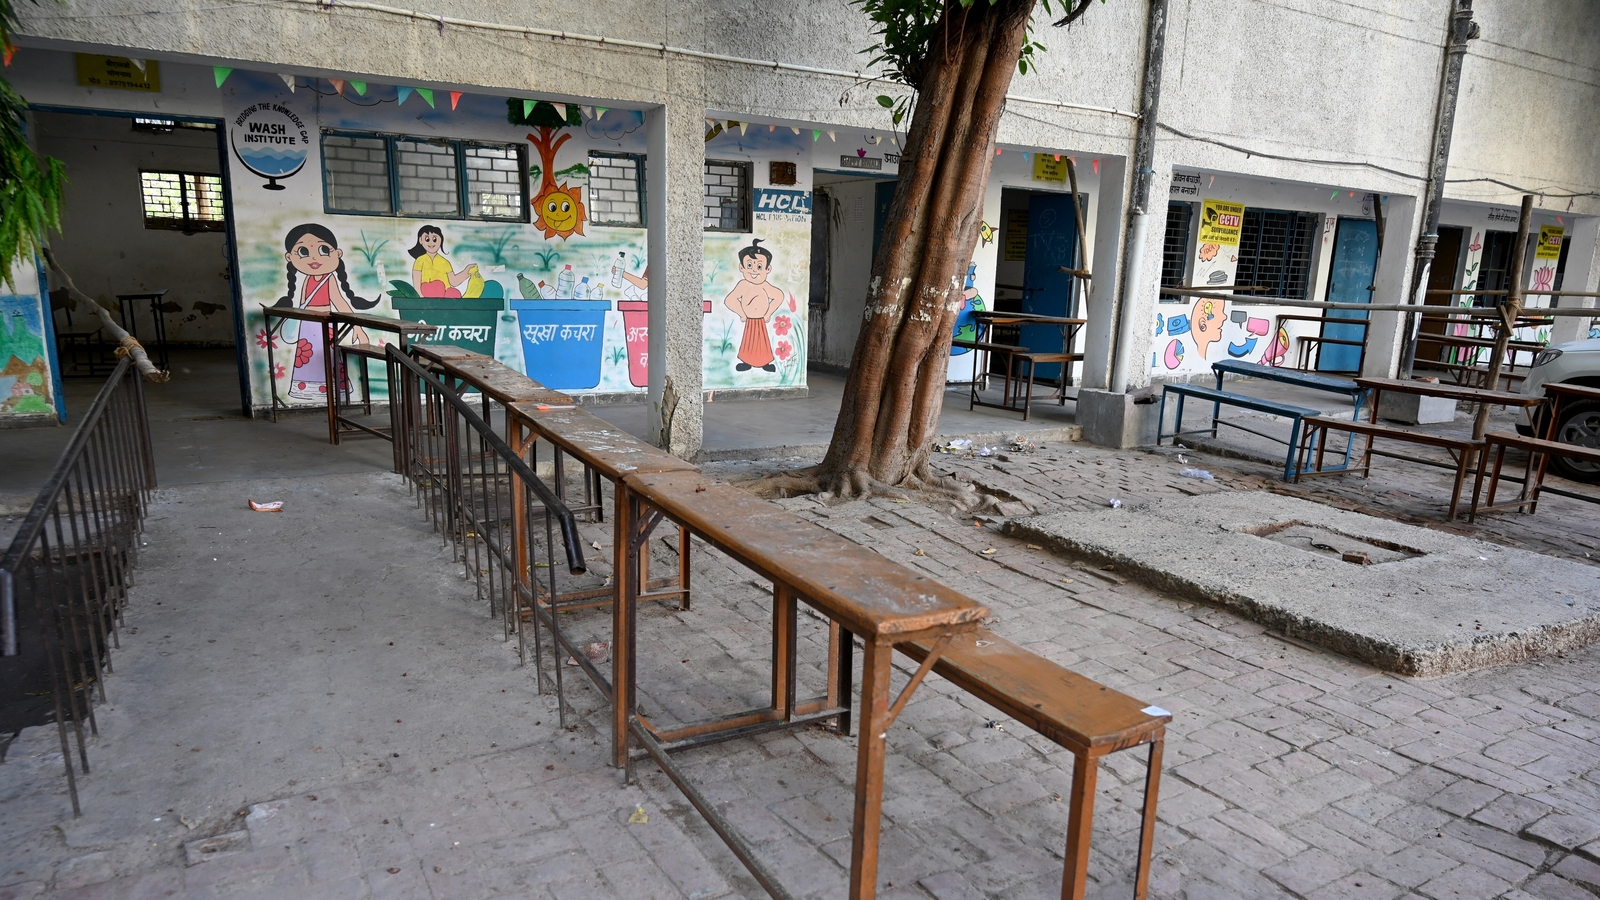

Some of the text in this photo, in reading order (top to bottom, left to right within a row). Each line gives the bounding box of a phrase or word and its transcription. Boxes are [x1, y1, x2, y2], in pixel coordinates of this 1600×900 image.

[109, 80, 151, 89] 8979194412
[235, 102, 309, 145] BRIDGING THE KNOWLEDGE GAP
[249, 122, 286, 135] WASH
[244, 134, 296, 145] INSTITUTE
[758, 193, 810, 213] HCL
[1230, 206, 1242, 214] UNDER
[756, 213, 766, 221] HCL
[1219, 213, 1240, 227] CCTV
[1211, 226, 1239, 236] SURVEILLANCE
[448, 325, 492, 343] कचरा
[523, 324, 598, 345] सूखा कचरा
